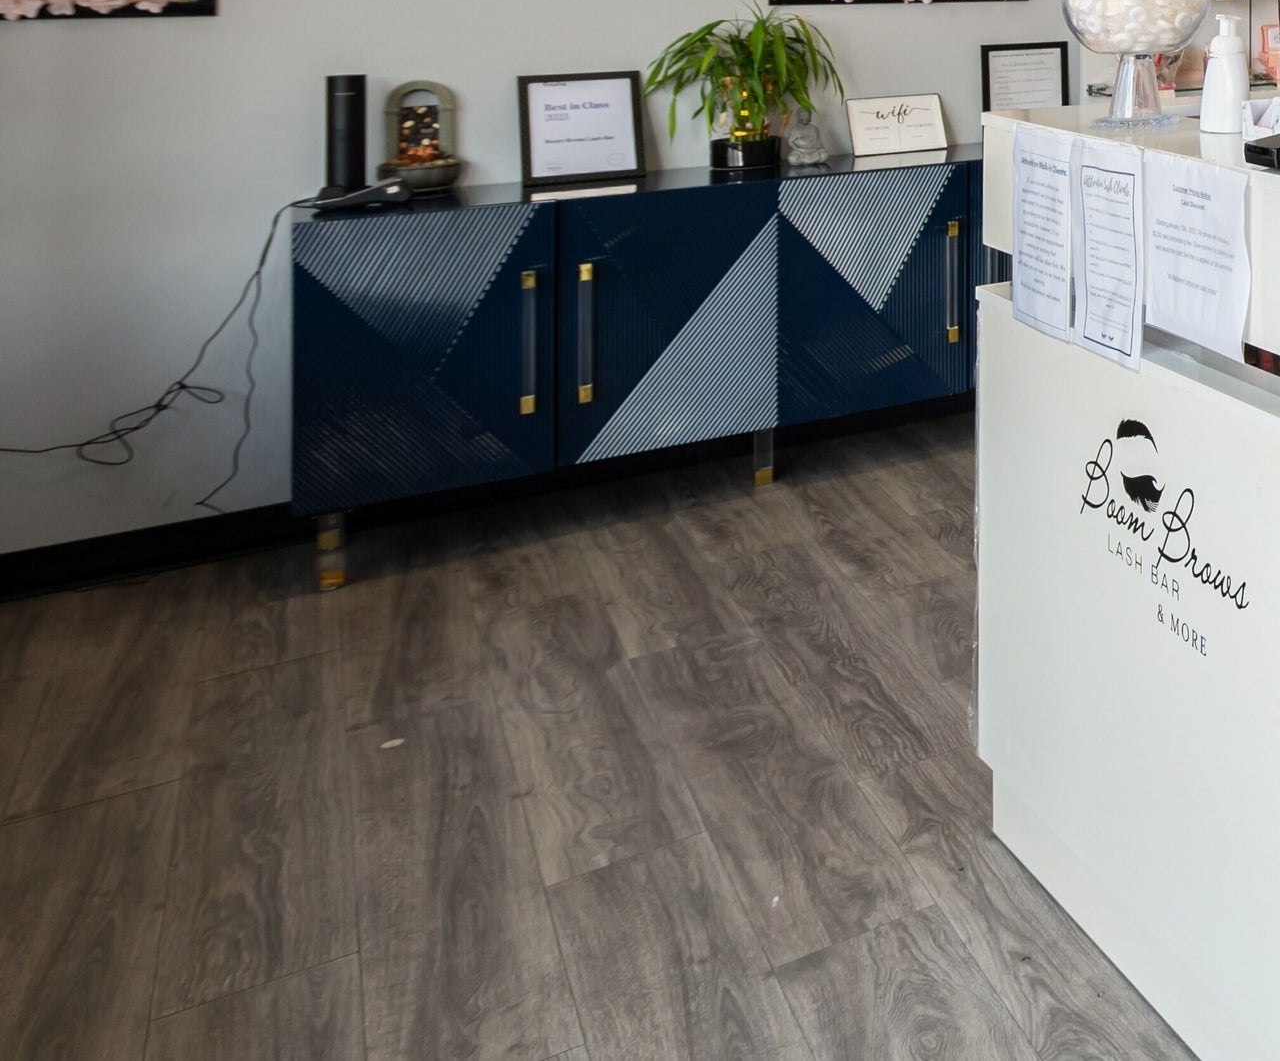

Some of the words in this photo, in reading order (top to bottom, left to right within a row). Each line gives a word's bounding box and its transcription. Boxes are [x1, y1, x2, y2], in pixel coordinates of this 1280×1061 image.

[544, 103, 567, 112] Best
[569, 102, 580, 110] in
[582, 101, 610, 110] Class
[1080, 438, 1154, 541] Boom
[1156, 488, 1250, 610] Brows
[1107, 533, 1143, 574] LASH
[1150, 565, 1180, 602] BAR
[1157, 604, 1164, 624] &
[1170, 613, 1207, 657] MORE
